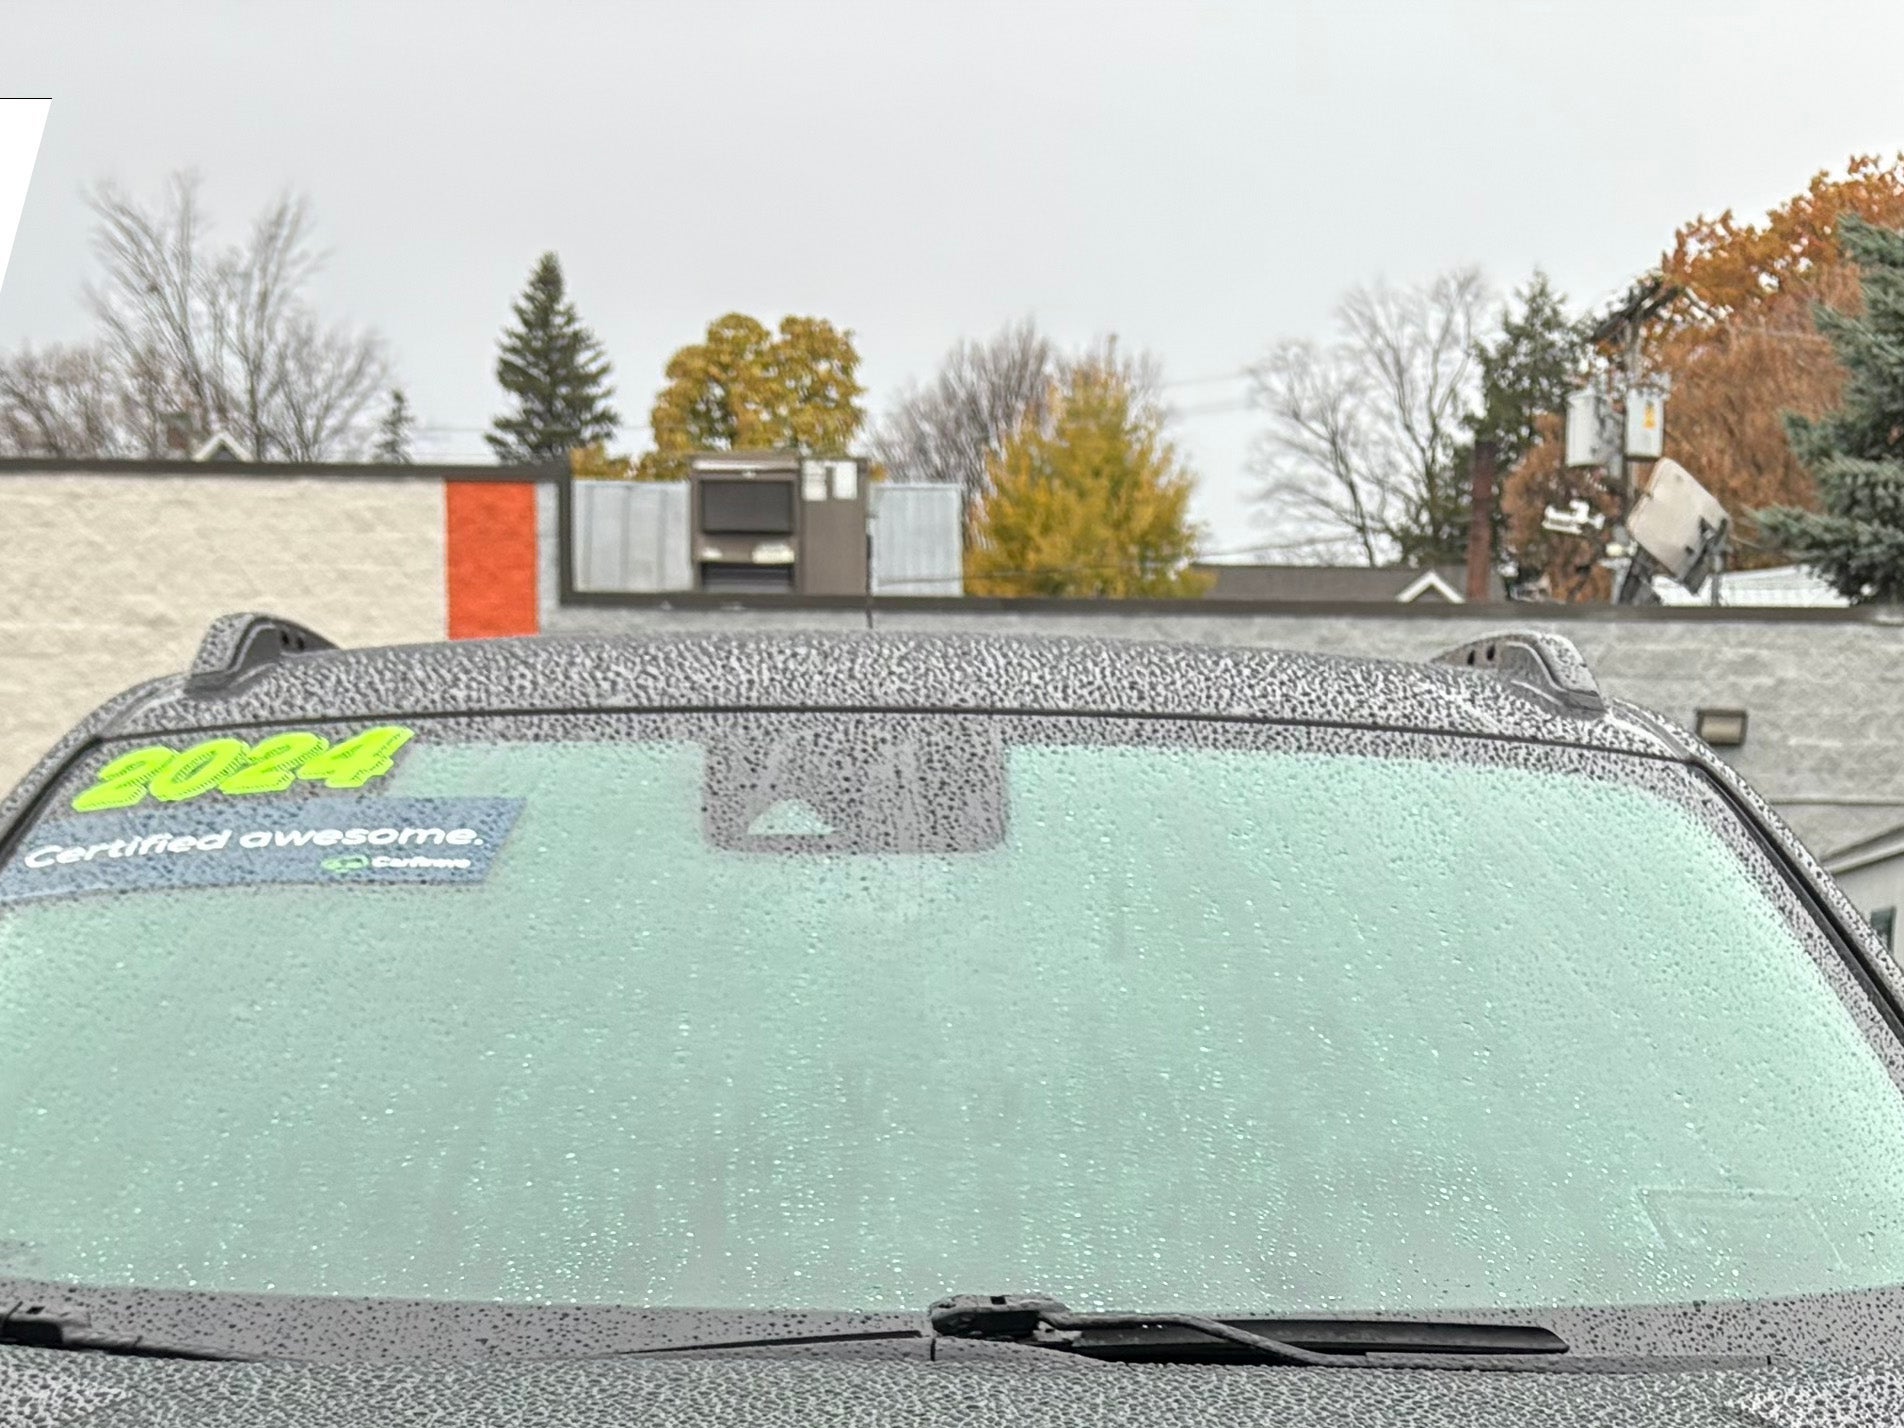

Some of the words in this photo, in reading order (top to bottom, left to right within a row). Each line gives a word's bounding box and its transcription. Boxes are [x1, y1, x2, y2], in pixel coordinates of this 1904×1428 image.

[72, 725, 415, 812] 2024
[24, 828, 232, 869] Certified
[239, 826, 484, 849] awesome.
